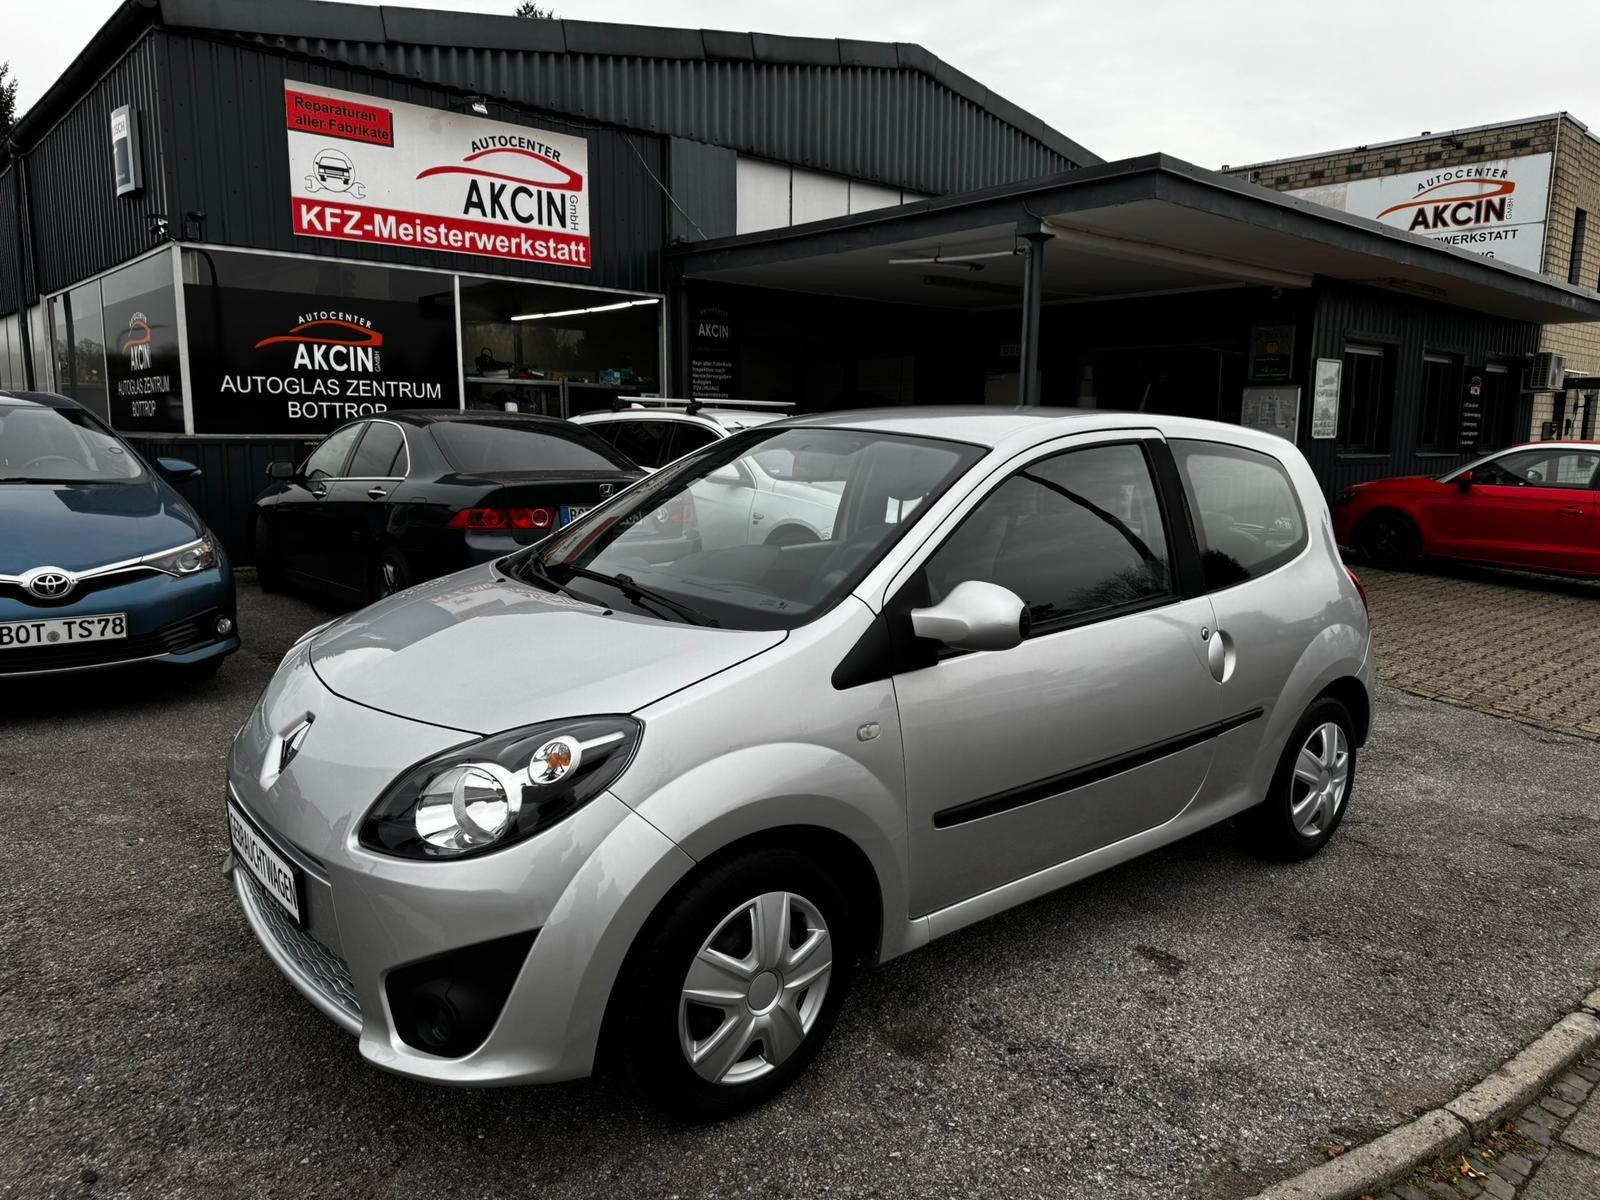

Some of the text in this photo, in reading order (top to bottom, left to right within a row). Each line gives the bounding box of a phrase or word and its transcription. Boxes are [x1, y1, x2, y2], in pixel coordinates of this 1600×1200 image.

[295, 96, 376, 121] Reparaturen
[295, 114, 389, 139] aller Fabrikate
[471, 135, 561, 162] AUTOCENTER
[1418, 168, 1508, 191] AUTOCENTER
[463, 179, 580, 231] AKCIN GmbH
[1408, 197, 1506, 231] AKCIN
[300, 204, 587, 263] KFZ-Meisterwerkstatt
[298, 311, 372, 329] AUTOCENTER
[698, 323, 729, 338] AKCIN
[293, 343, 374, 372] AKCIN
[118, 375, 170, 395] AUTOGLAS ZENTRUM
[220, 375, 441, 399] AUTOGLAS ZENTRUM
[132, 400, 156, 416] BOTTROP
[0, 623, 46, 645] BOT
